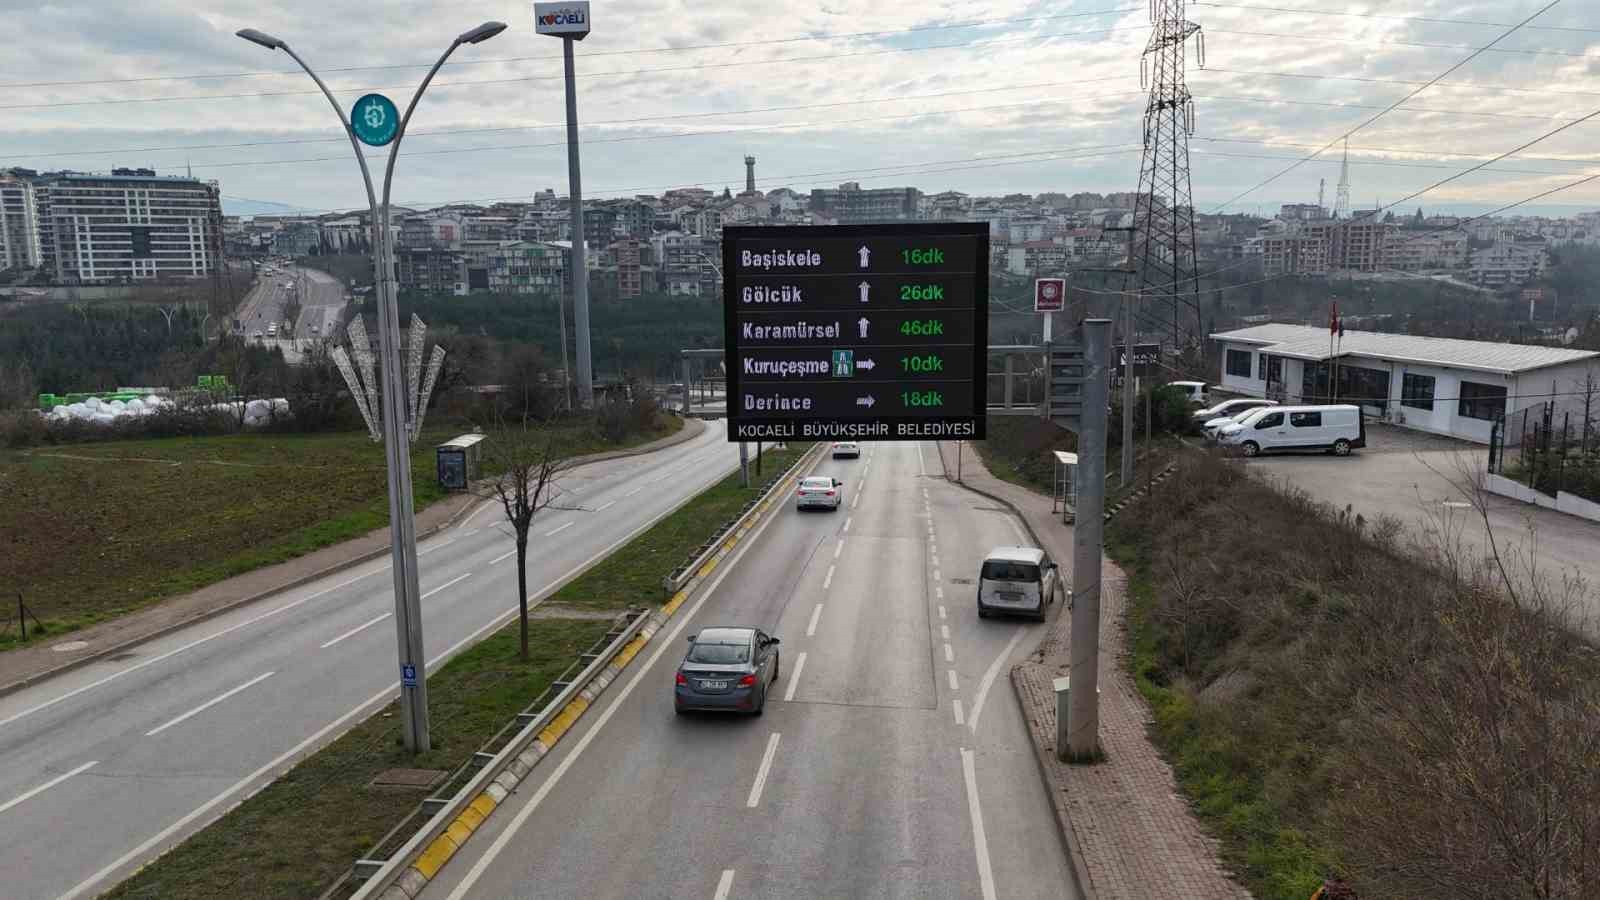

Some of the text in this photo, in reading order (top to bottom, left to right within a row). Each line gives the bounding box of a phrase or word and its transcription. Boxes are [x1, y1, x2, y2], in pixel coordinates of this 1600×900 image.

[741, 247, 945, 270] Başiskele 16dk
[743, 284, 944, 303] Gölcük 26dk
[743, 320, 944, 339] Karamürsel 46dk
[743, 356, 944, 377] Kuruçeşme 10dk
[744, 391, 944, 411] Derince 18dk
[738, 420, 976, 437] KOCAELİ BÜYÜKŞEHİR BELEDİYESİ
